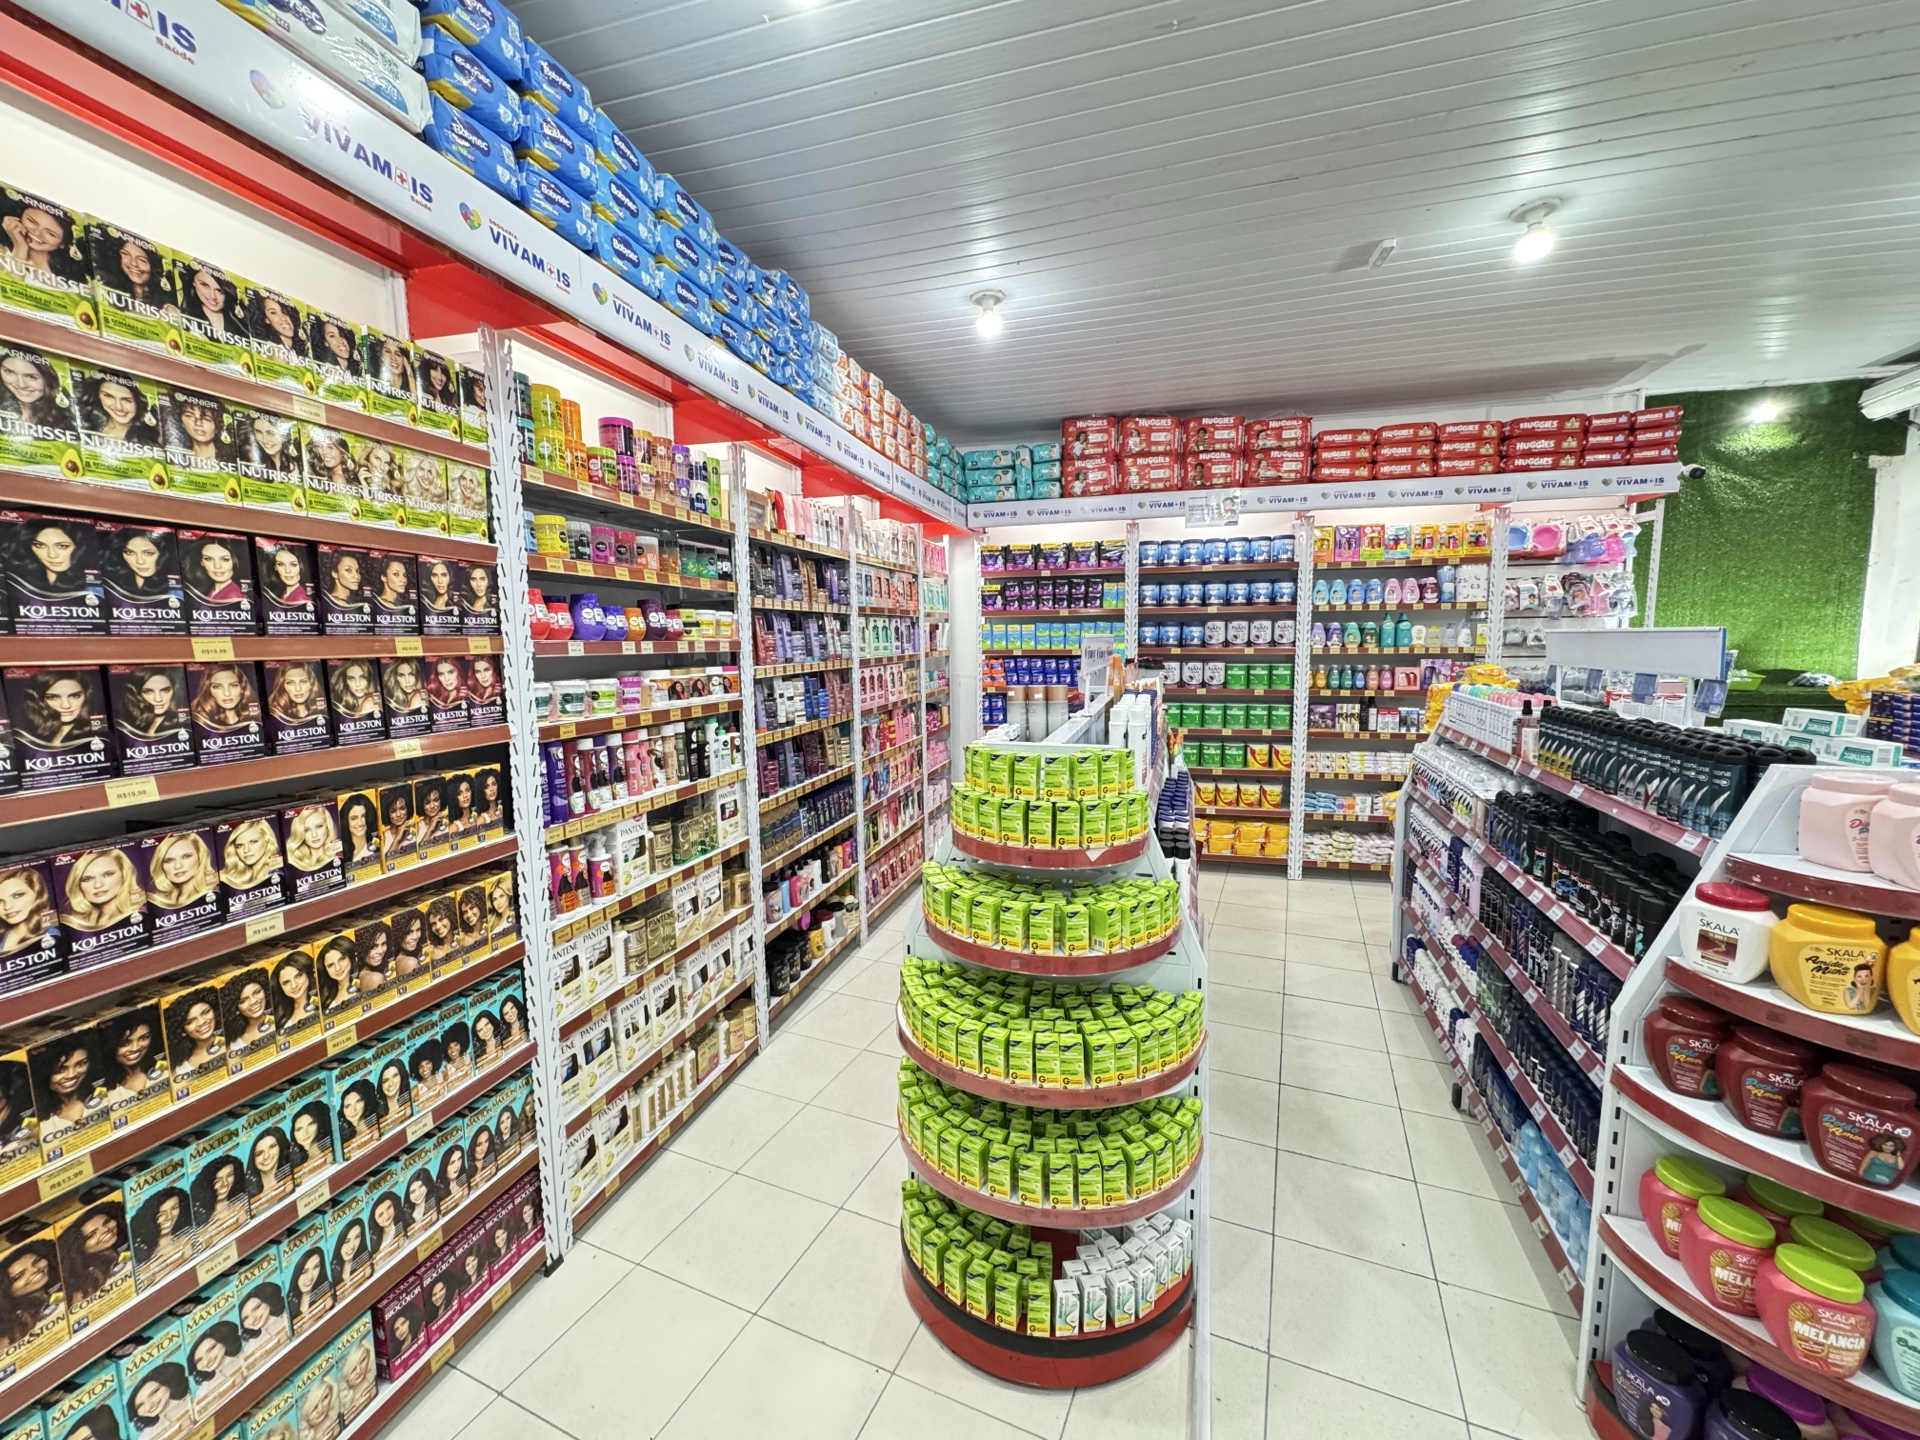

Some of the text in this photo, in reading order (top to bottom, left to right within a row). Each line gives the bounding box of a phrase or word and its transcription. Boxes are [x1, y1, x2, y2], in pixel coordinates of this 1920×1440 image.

[276, 17, 290, 31] SEC
[6, 188, 64, 218] GARNIER
[108, 227, 156, 252] GARNIER
[0, 256, 92, 298] NUTRISSE
[189, 260, 231, 282] GARNIER
[102, 289, 179, 326] NUTRISSE
[181, 316, 250, 349] NUTRISSE
[253, 340, 312, 368] NUTRISSE
[90, 370, 140, 388] GARNIER
[174, 392, 218, 409] GARNIER
[371, 380, 417, 402] NUTRISSE
[418, 396, 458, 415] NUTRISSE
[1076, 419, 1107, 428] HUGGIES
[1138, 418, 1172, 427] HUGGIES
[1202, 416, 1235, 425] HUGGIES
[1269, 419, 1303, 428] HUGGIES
[1446, 424, 1479, 433] HUGGIES
[1520, 421, 1558, 430] HUGGIES
[0, 419, 78, 445] UTRISSE
[81, 434, 165, 460] NUTRISSE
[1270, 450, 1304, 459] HUGGIES
[1516, 440, 1554, 450] HUGGIES
[167, 451, 239, 474] NUTRISSE
[1074, 457, 1106, 467] HUGGIES
[1137, 456, 1170, 465] HUGGIES
[1380, 464, 1412, 473] HUGGIES
[1441, 459, 1475, 468] HUGGIES
[1514, 457, 1553, 466] HUGGIES
[241, 465, 302, 486] NUTRISSE
[306, 477, 360, 495] NUTRISSE
[359, 487, 404, 504] NUTRISSE
[406, 497, 447, 512] NUTRISSE
[19, 605, 100, 619] KOLESTON
[112, 608, 181, 620] KOLESTON
[192, 610, 251, 621] KOLESTON
[269, 612, 315, 622] KOLESTON
[327, 613, 371, 623] KOLESTON
[339, 719, 382, 732] KOLESTON
[391, 713, 429, 726] KOLESTON
[202, 733, 260, 749] KOLESTON
[278, 726, 326, 740] KOLESTON
[126, 742, 190, 758] KOLESTON
[1843, 751, 1872, 764] elmex
[25, 751, 105, 770] KOLESTON
[117, 789, 147, 800] R$19,99
[1015, 787, 1022, 795] G
[1046, 789, 1053, 797] G
[620, 822, 646, 837] PANTENE
[296, 867, 342, 889] KOLESTON
[675, 877, 698, 896] PANTENE
[229, 884, 281, 907] KOLESTON
[155, 903, 217, 928] KOLESTON
[582, 923, 611, 944] PANTENE
[1699, 918, 1739, 936] SKALA
[72, 924, 144, 952] KOLESTON
[710, 933, 731, 951] PANTENE
[0, 948, 57, 972] LESTON
[552, 941, 579, 961] ANTENE
[1826, 947, 1865, 958] SKALA
[1805, 955, 1844, 968] Amido
[1811, 966, 1848, 975] Milho
[652, 974, 674, 995] PANTENE
[620, 992, 648, 1015] PANTENE
[580, 1014, 609, 1040] PANTENE
[1062, 1077, 1070, 1085] G
[1768, 1073, 1804, 1086] SKALA
[286, 1080, 326, 1103] MAXTON
[1751, 1088, 1783, 1100] Amor
[598, 1094, 627, 1121] PANTENE
[241, 1103, 287, 1132] MAXTON
[1847, 1111, 1893, 1132] SKALA
[1829, 1127, 1865, 1143] Amor
[1855, 1122, 1884, 1133] EXPERT
[189, 1129, 239, 1162] MAXTON
[50, 1170, 84, 1191] R$13,99
[129, 1158, 184, 1195] MAXTON
[327, 1196, 363, 1227] MAXTON
[485, 1203, 514, 1230] BIOCOLOR
[282, 1223, 323, 1258] MAXTON
[455, 1228, 485, 1258] BIOCOLOR
[235, 1255, 277, 1289] MAXTON
[422, 1255, 456, 1287] BIOCOLOR
[185, 1291, 235, 1332] MAXTON
[385, 1286, 421, 1321] BIOCOLOR
[996, 1315, 1004, 1323] G
[1817, 1308, 1856, 1325] SKALA
[336, 1319, 370, 1354] MAXTON
[1793, 1320, 1865, 1350] MELANCIA
[125, 1331, 181, 1377] MAXTON
[296, 1354, 334, 1392] MAXTON
[1626, 1369, 1655, 1395] SKALA
[51, 1375, 115, 1426] MAXTON
[250, 1392, 294, 1434] MAXTON
